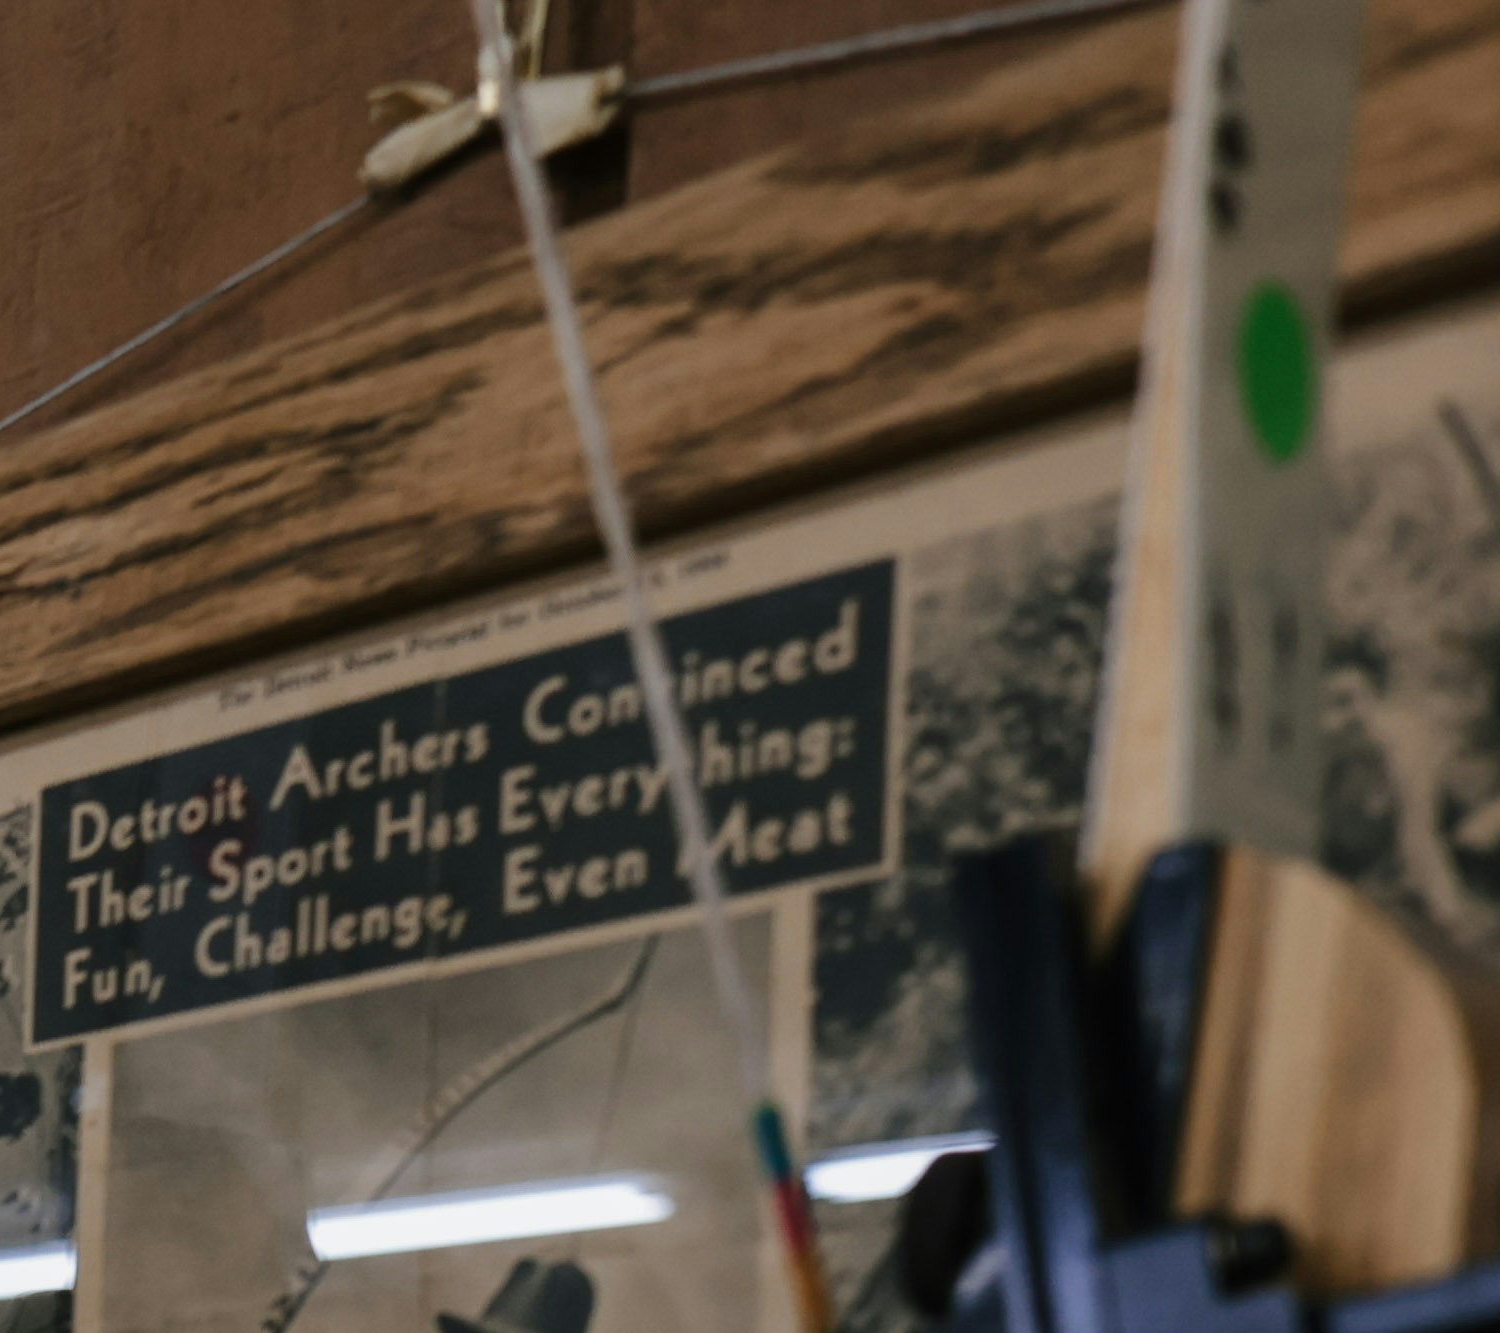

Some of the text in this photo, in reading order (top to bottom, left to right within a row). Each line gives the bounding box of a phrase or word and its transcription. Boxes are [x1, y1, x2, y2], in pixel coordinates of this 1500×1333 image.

[66, 599, 859, 864] Detroit Archers Coninced
[66, 712, 858, 936] Their Sport Has Everyhing:
[61, 948, 163, 1011] Fun,
[193, 888, 470, 982] Challenge,
[500, 842, 648, 916] Even
